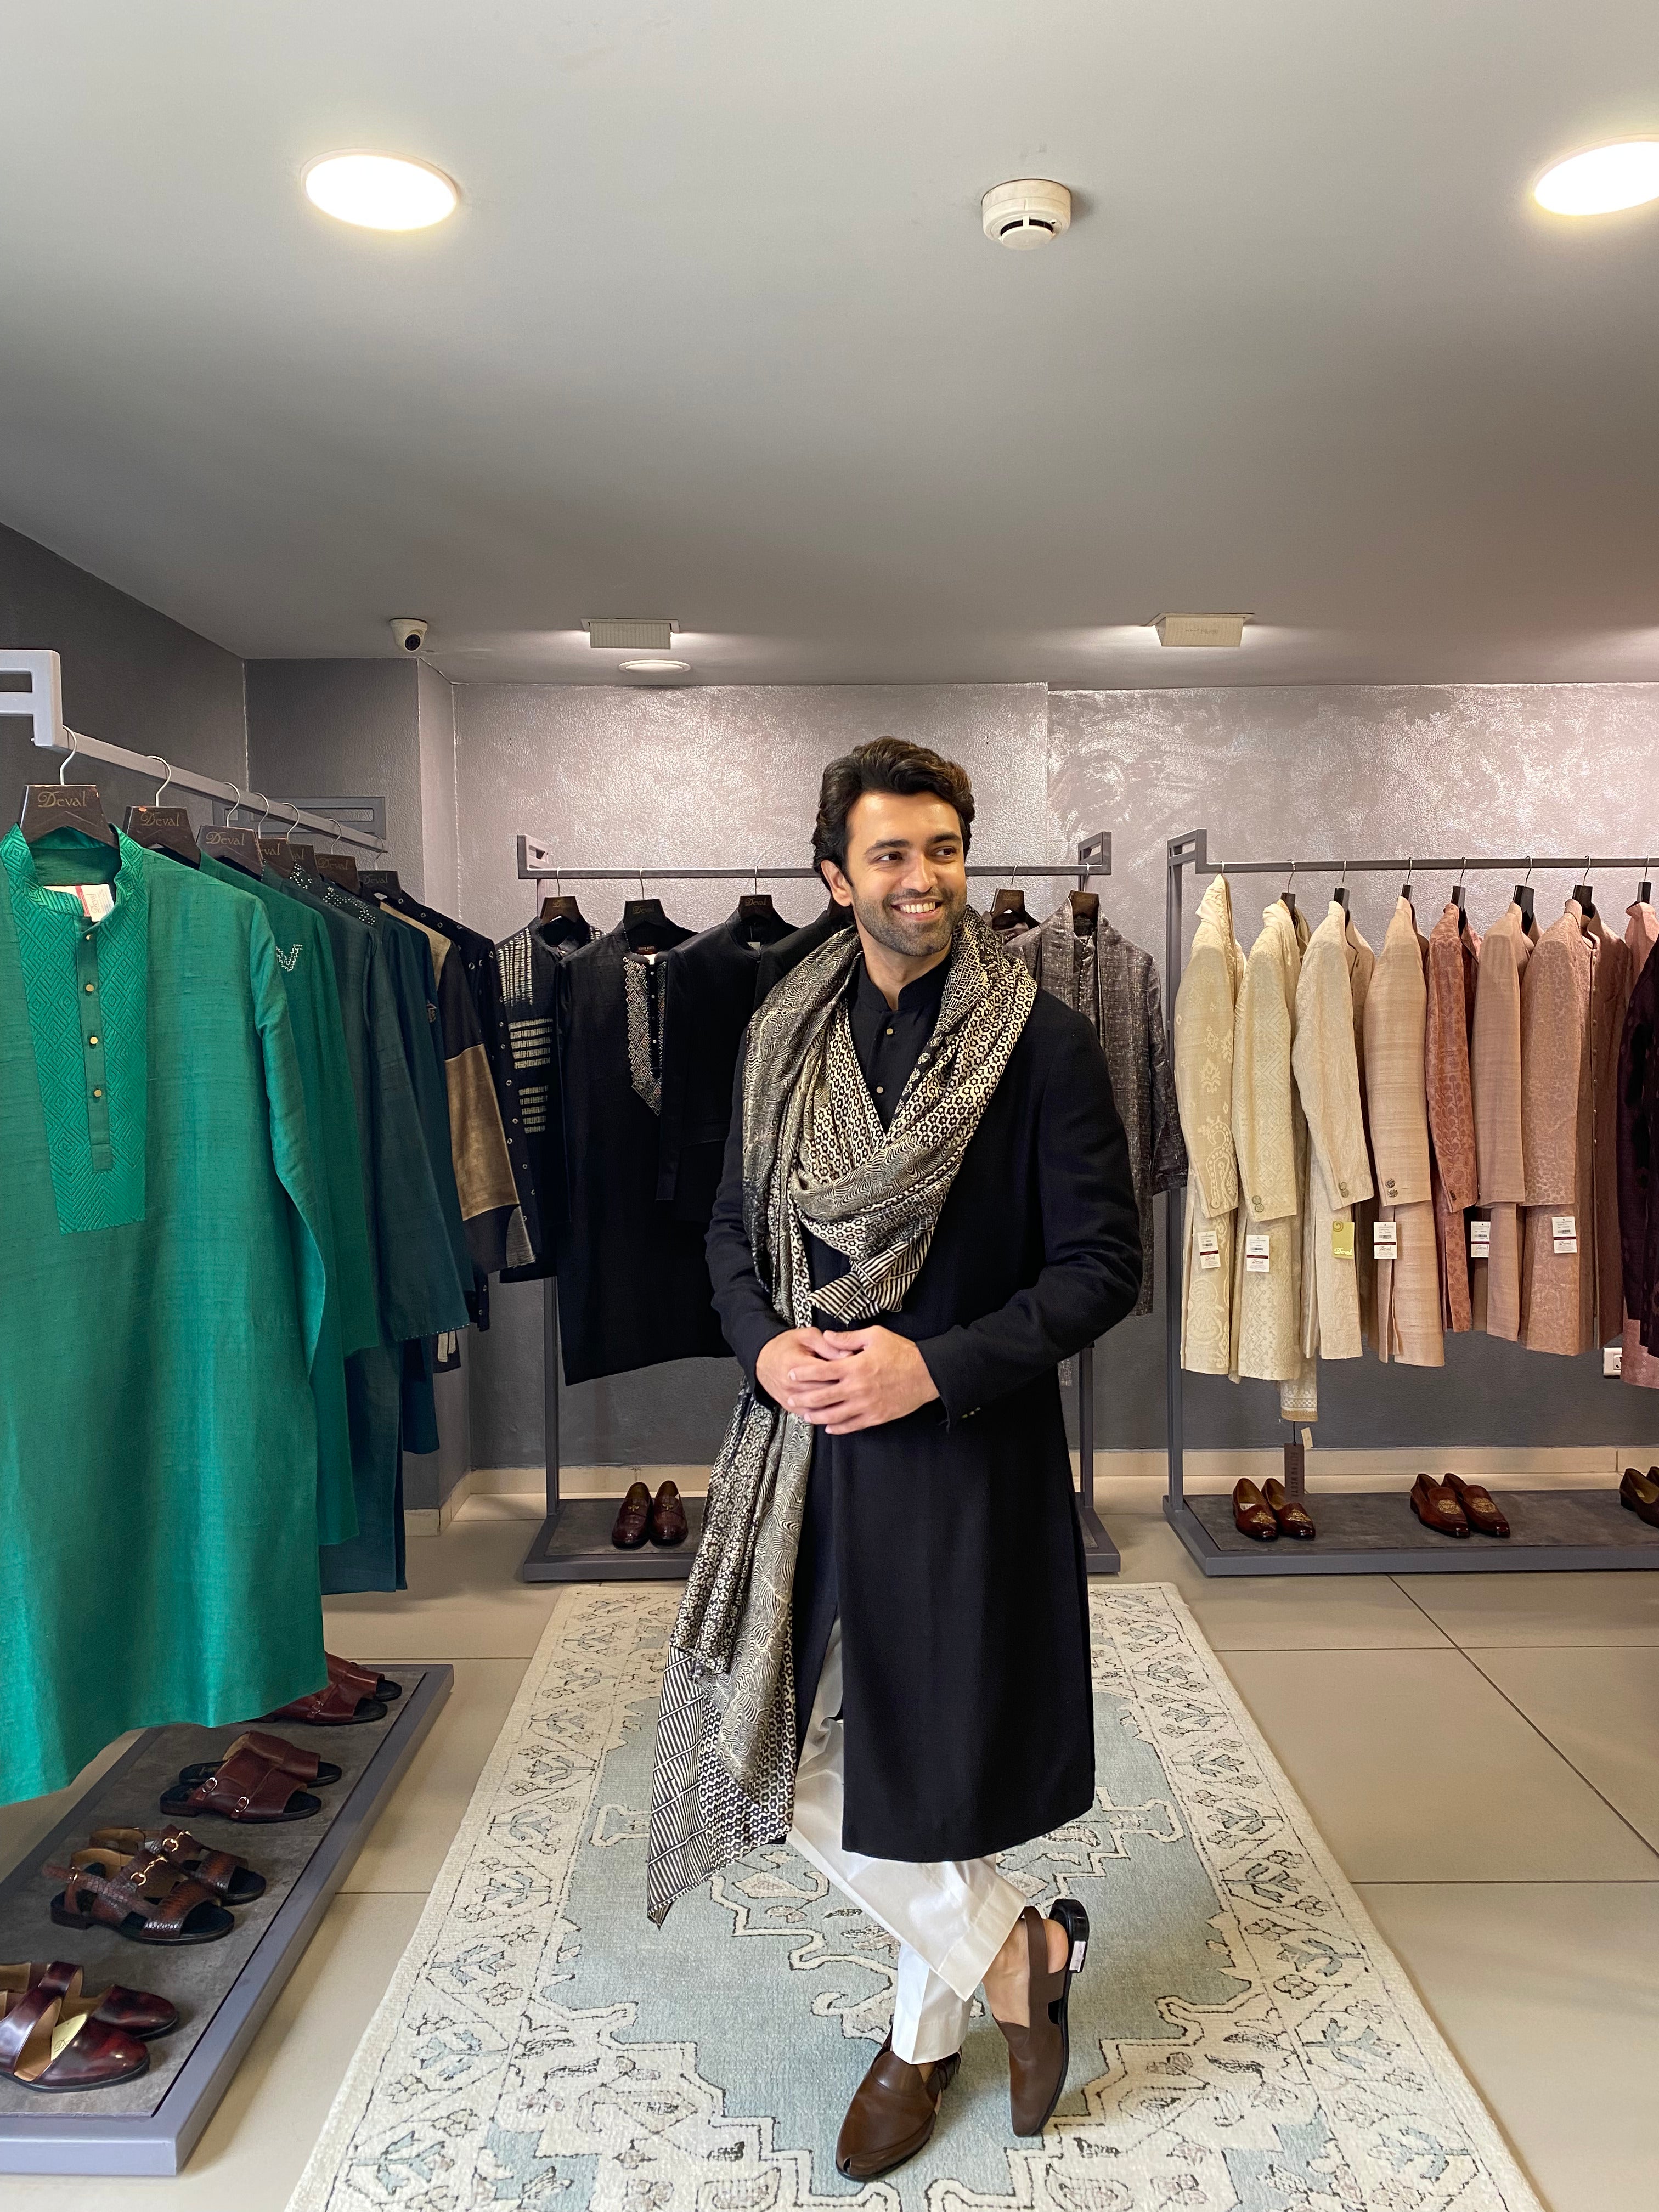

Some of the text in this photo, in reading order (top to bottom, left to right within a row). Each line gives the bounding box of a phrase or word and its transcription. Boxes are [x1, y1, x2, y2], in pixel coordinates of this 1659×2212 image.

[38, 791, 87, 808] Deval
[140, 812, 180, 827] Deval
[206, 831, 245, 846] Deval
